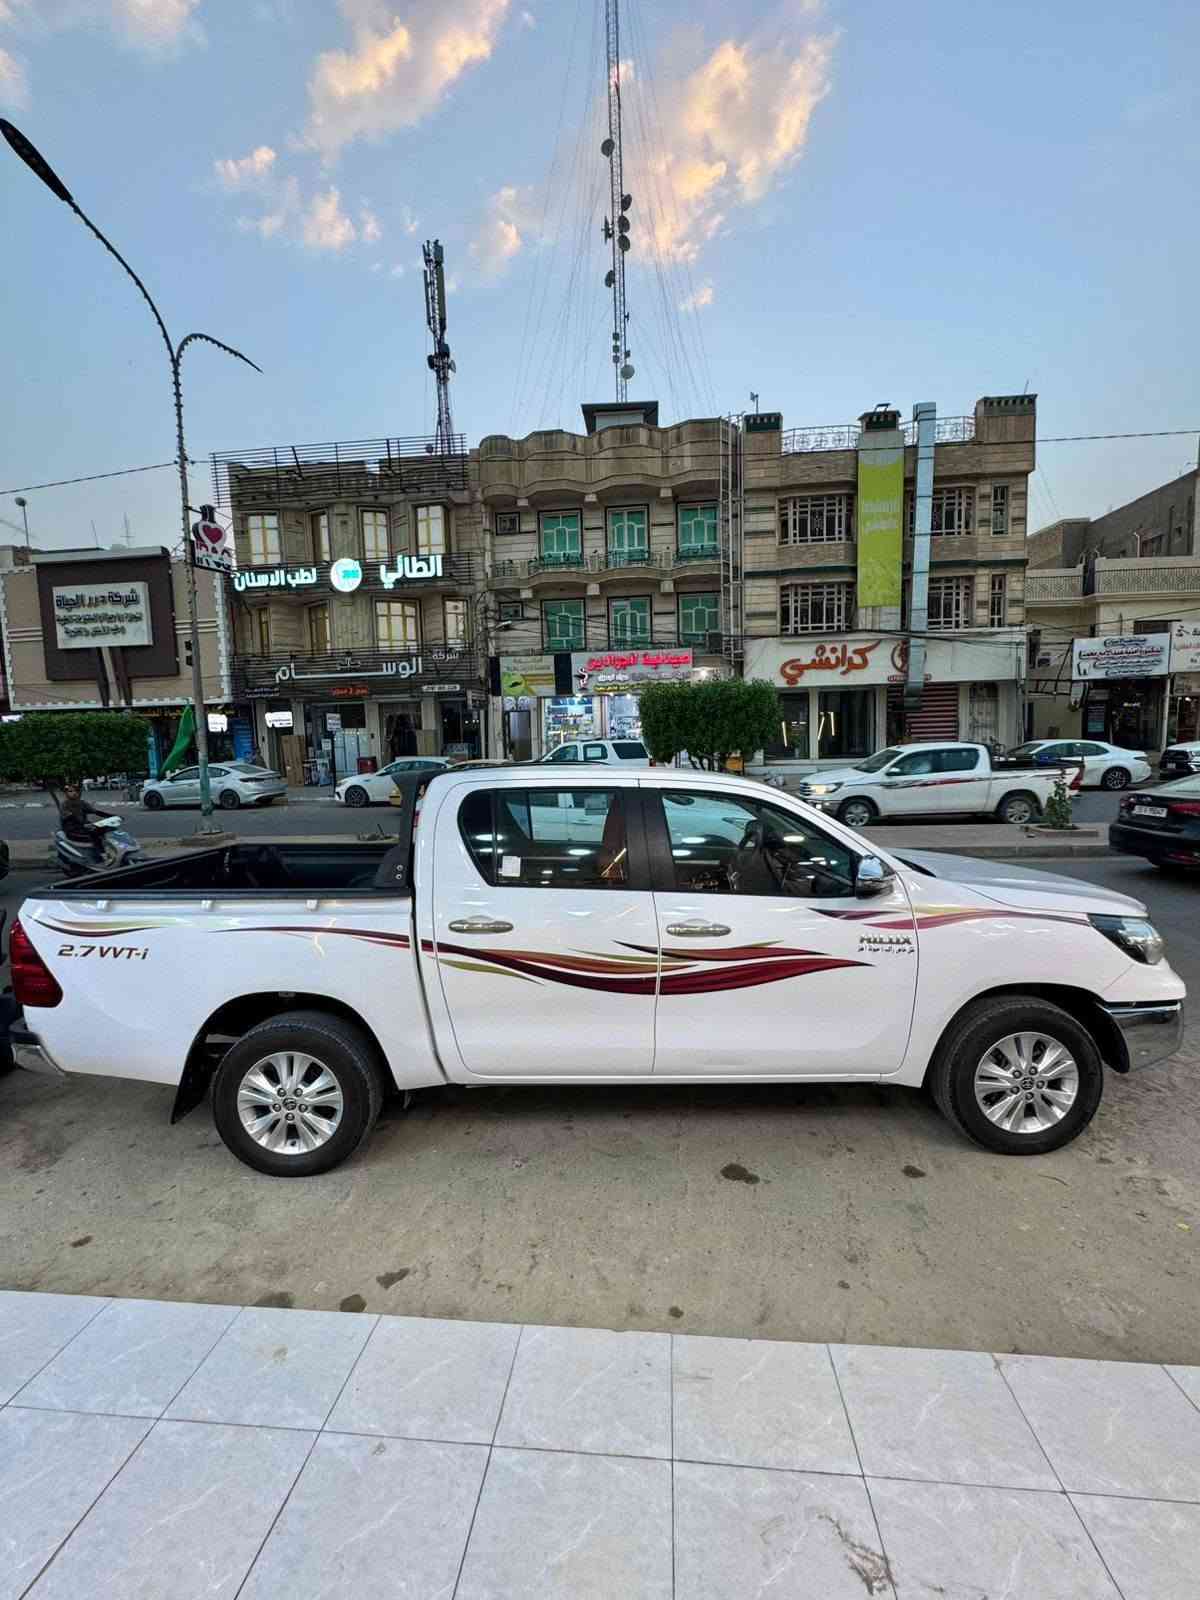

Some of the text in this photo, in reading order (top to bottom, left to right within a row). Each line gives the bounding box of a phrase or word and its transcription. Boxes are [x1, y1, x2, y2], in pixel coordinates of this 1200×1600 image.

[287, 567, 317, 587] لطب
[380, 554, 443, 589] الطائي
[108, 588, 138, 608] شركة
[433, 648, 460, 662] شركة
[643, 652, 691, 669] صيدلية
[780, 639, 881, 686] كرانشي
[275, 656, 422, 683] الوسام
[859, 934, 912, 945] HILUX
[57, 944, 149, 960] 2.7 VVT-i
